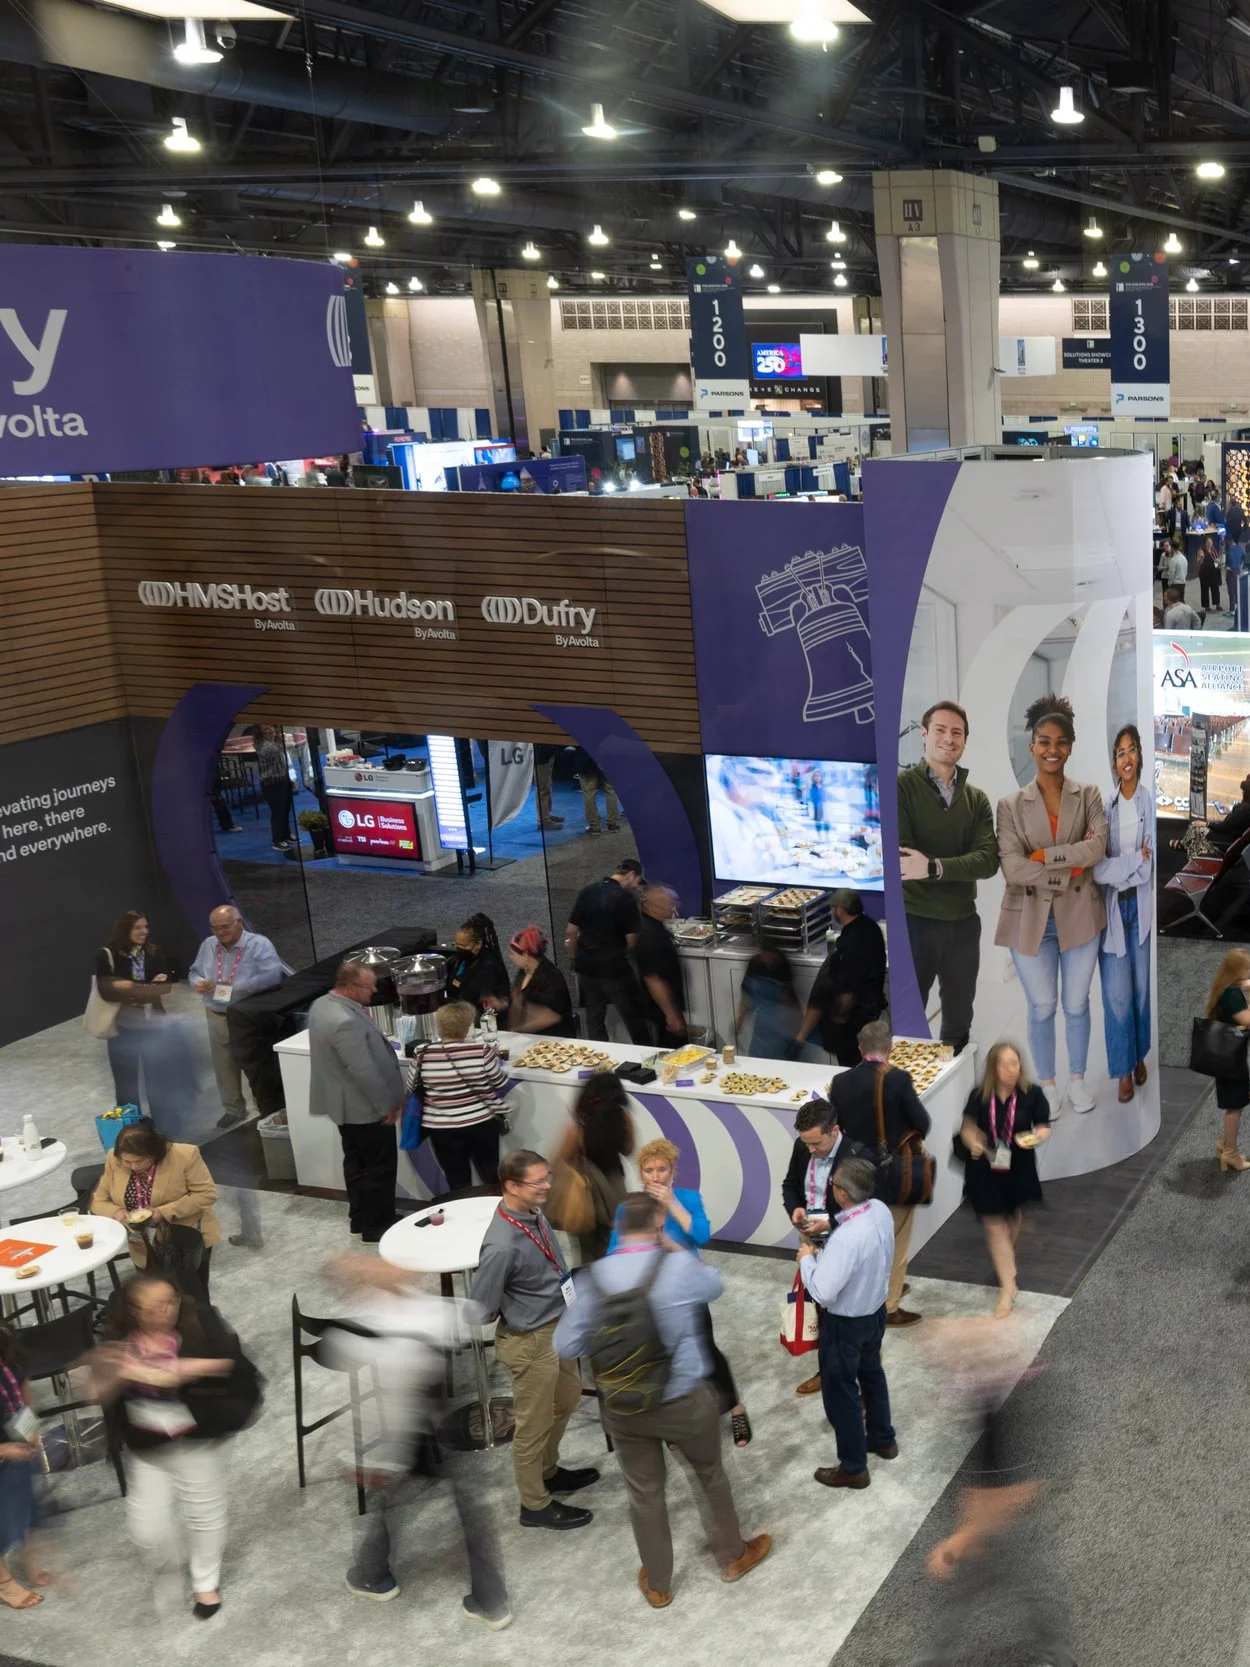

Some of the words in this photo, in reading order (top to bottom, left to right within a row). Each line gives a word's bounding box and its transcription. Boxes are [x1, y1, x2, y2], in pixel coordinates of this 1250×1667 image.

[712, 299, 727, 367] 1200
[1133, 298, 1147, 370] 1300
[0, 308, 68, 396] y
[174, 581, 291, 613] HMSHost
[354, 590, 455, 621] Hudson
[522, 597, 596, 634] Dufry
[266, 620, 296, 631] Avolta
[427, 628, 456, 640] Avolta
[568, 636, 600, 648] Avolta
[1161, 668, 1198, 688] ASA
[1201, 664, 1244, 673] AIRPORT
[1201, 674, 1244, 682] SEATING
[1201, 682, 1244, 691] ALLIANCE
[500, 747, 524, 766] LG
[52, 776, 116, 807] journeys
[2, 820, 43, 839] here,
[44, 807, 85, 827] there
[356, 814, 375, 828] LG
[380, 816, 405, 825] Business
[380, 823, 408, 831] Solutions
[20, 822, 111, 857] everywhere.
